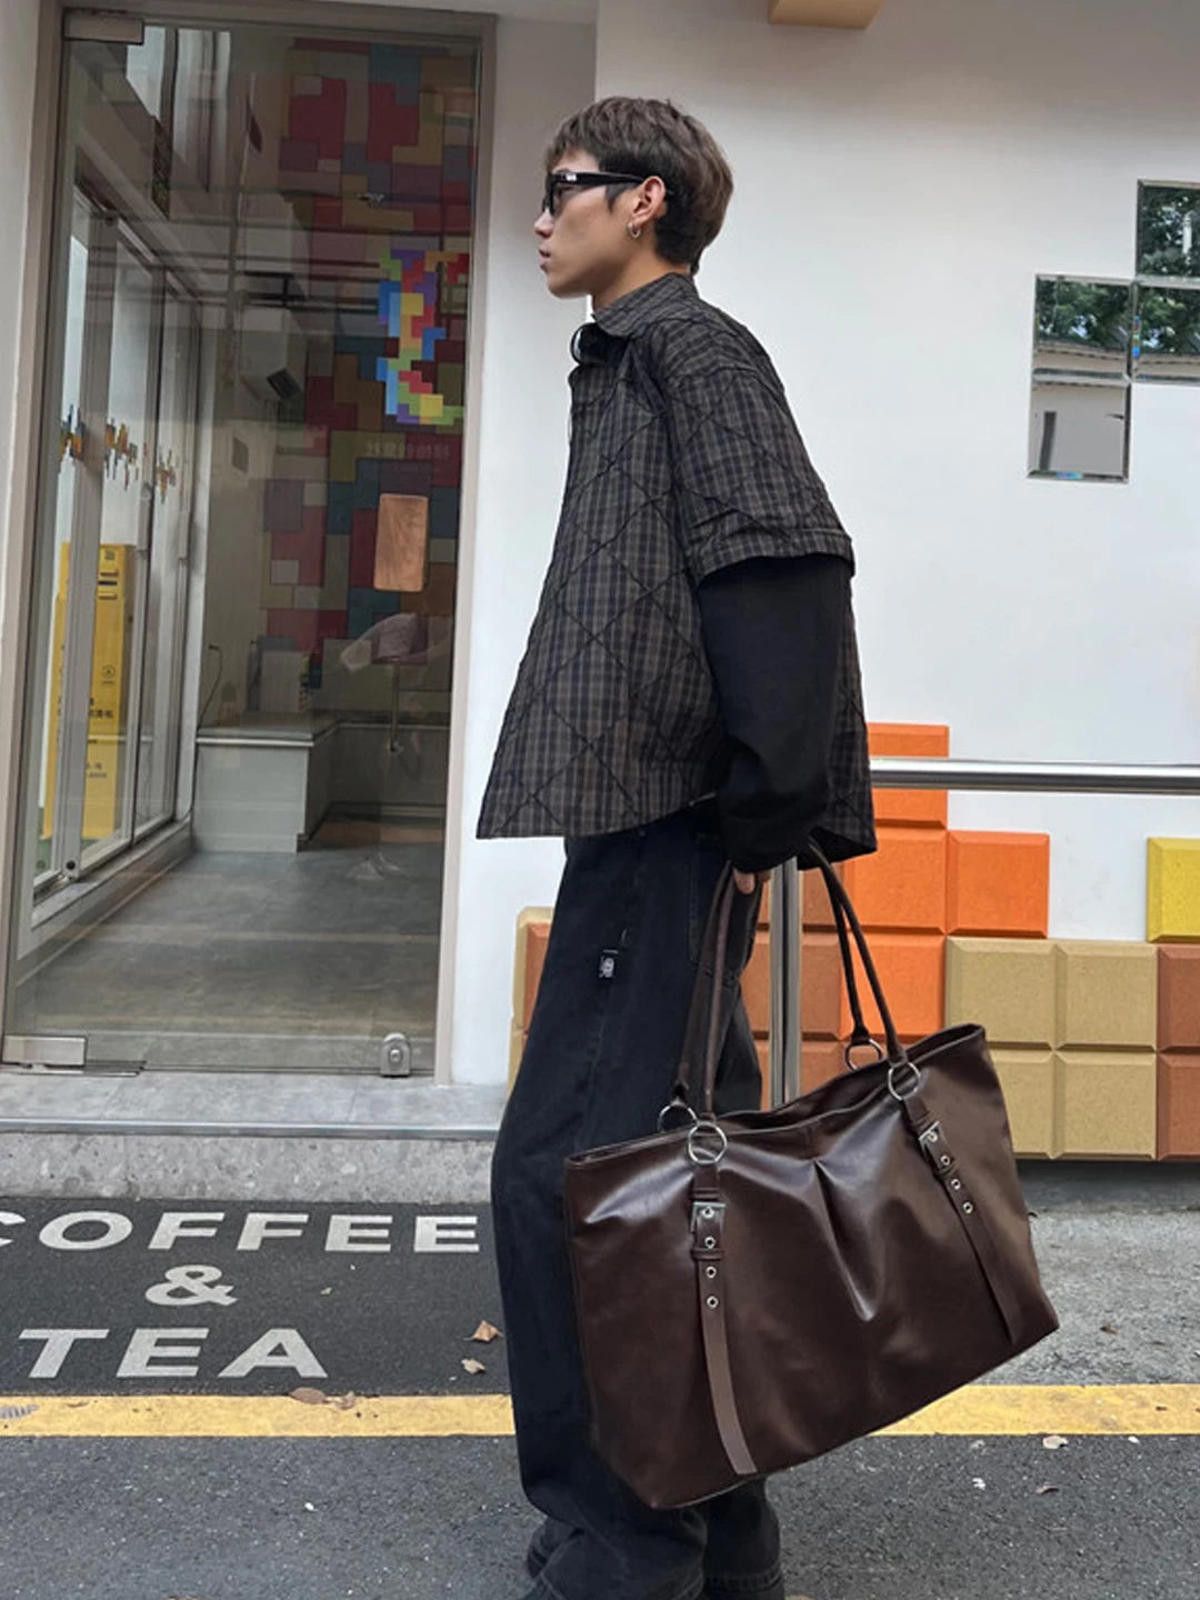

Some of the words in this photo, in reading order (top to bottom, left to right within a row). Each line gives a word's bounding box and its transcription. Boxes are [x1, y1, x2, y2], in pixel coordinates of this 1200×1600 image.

[0, 1211, 480, 1253] OFFEE
[145, 1264, 237, 1306] &
[19, 1328, 327, 1378] TEA
